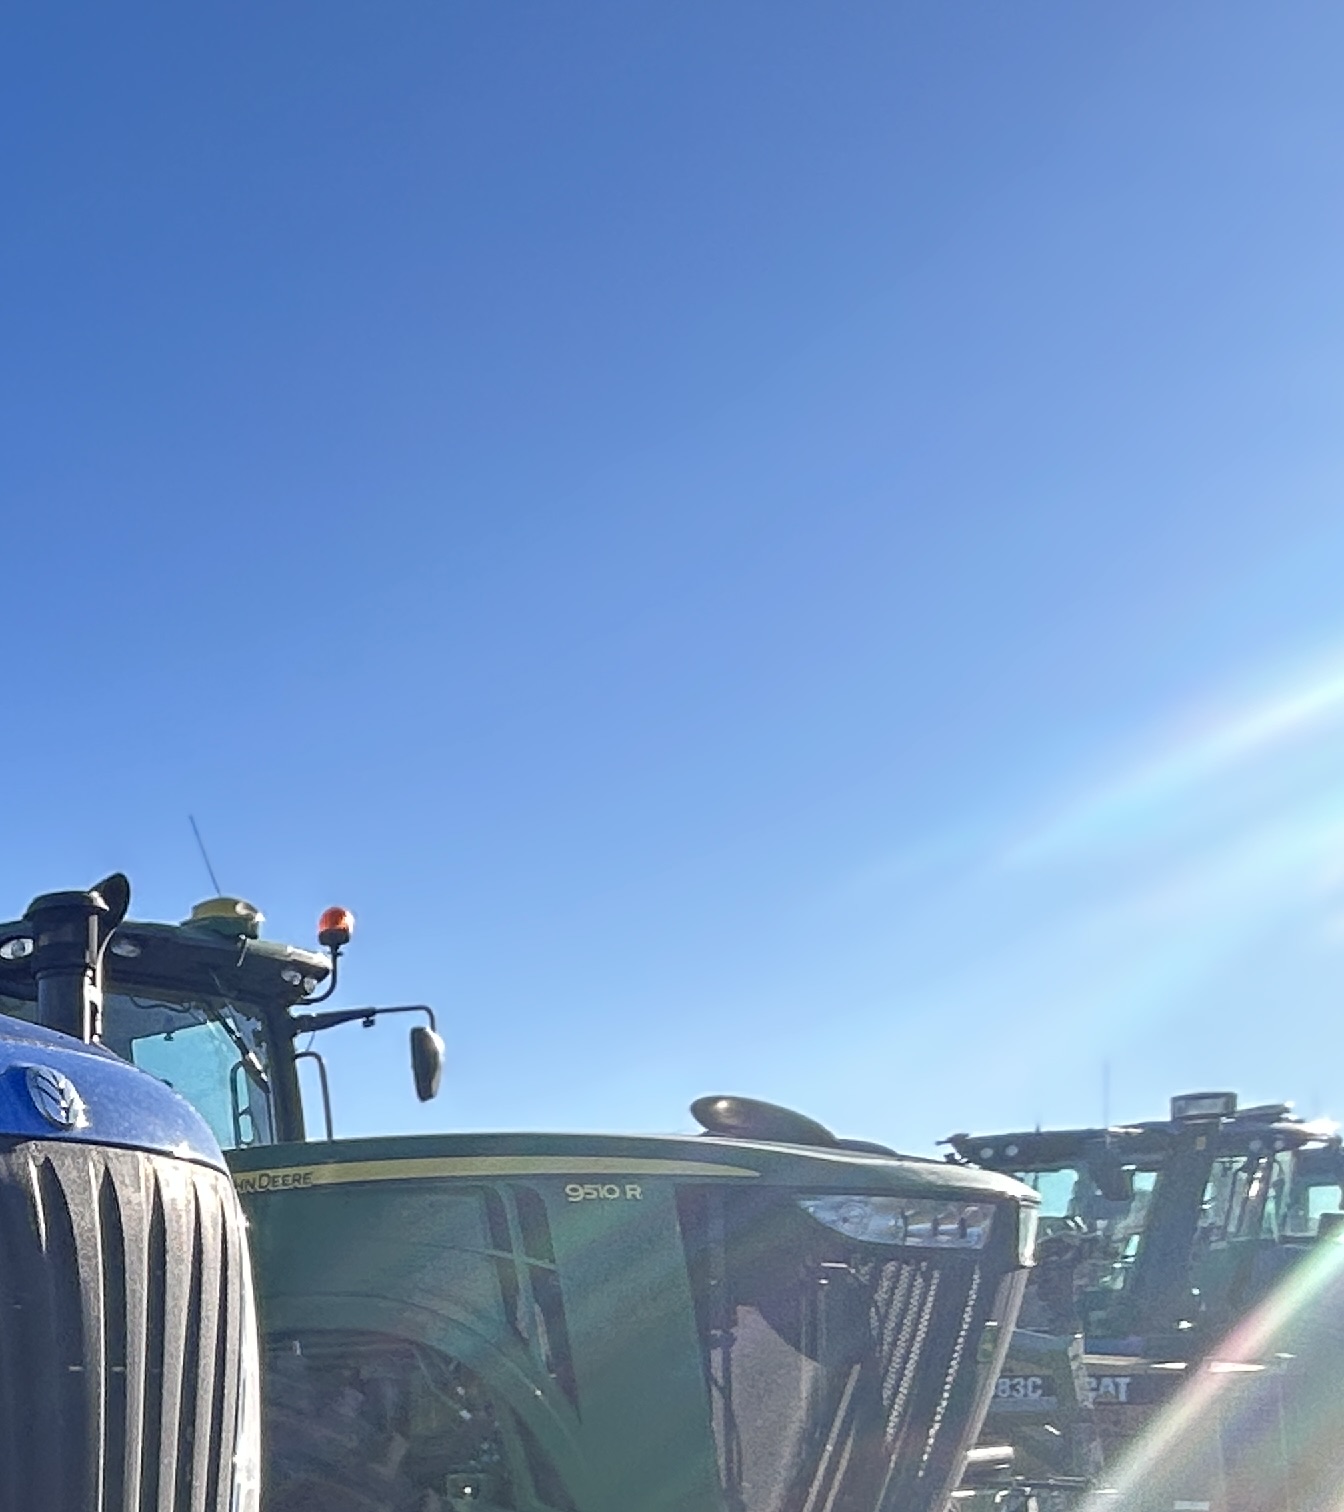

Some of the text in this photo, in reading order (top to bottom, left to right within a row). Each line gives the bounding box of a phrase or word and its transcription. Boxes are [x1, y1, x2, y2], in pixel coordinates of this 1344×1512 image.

[258, 1172, 313, 1190] DEERE
[564, 1183, 643, 1202] 9510 R
[996, 1376, 1043, 1399] 83C
